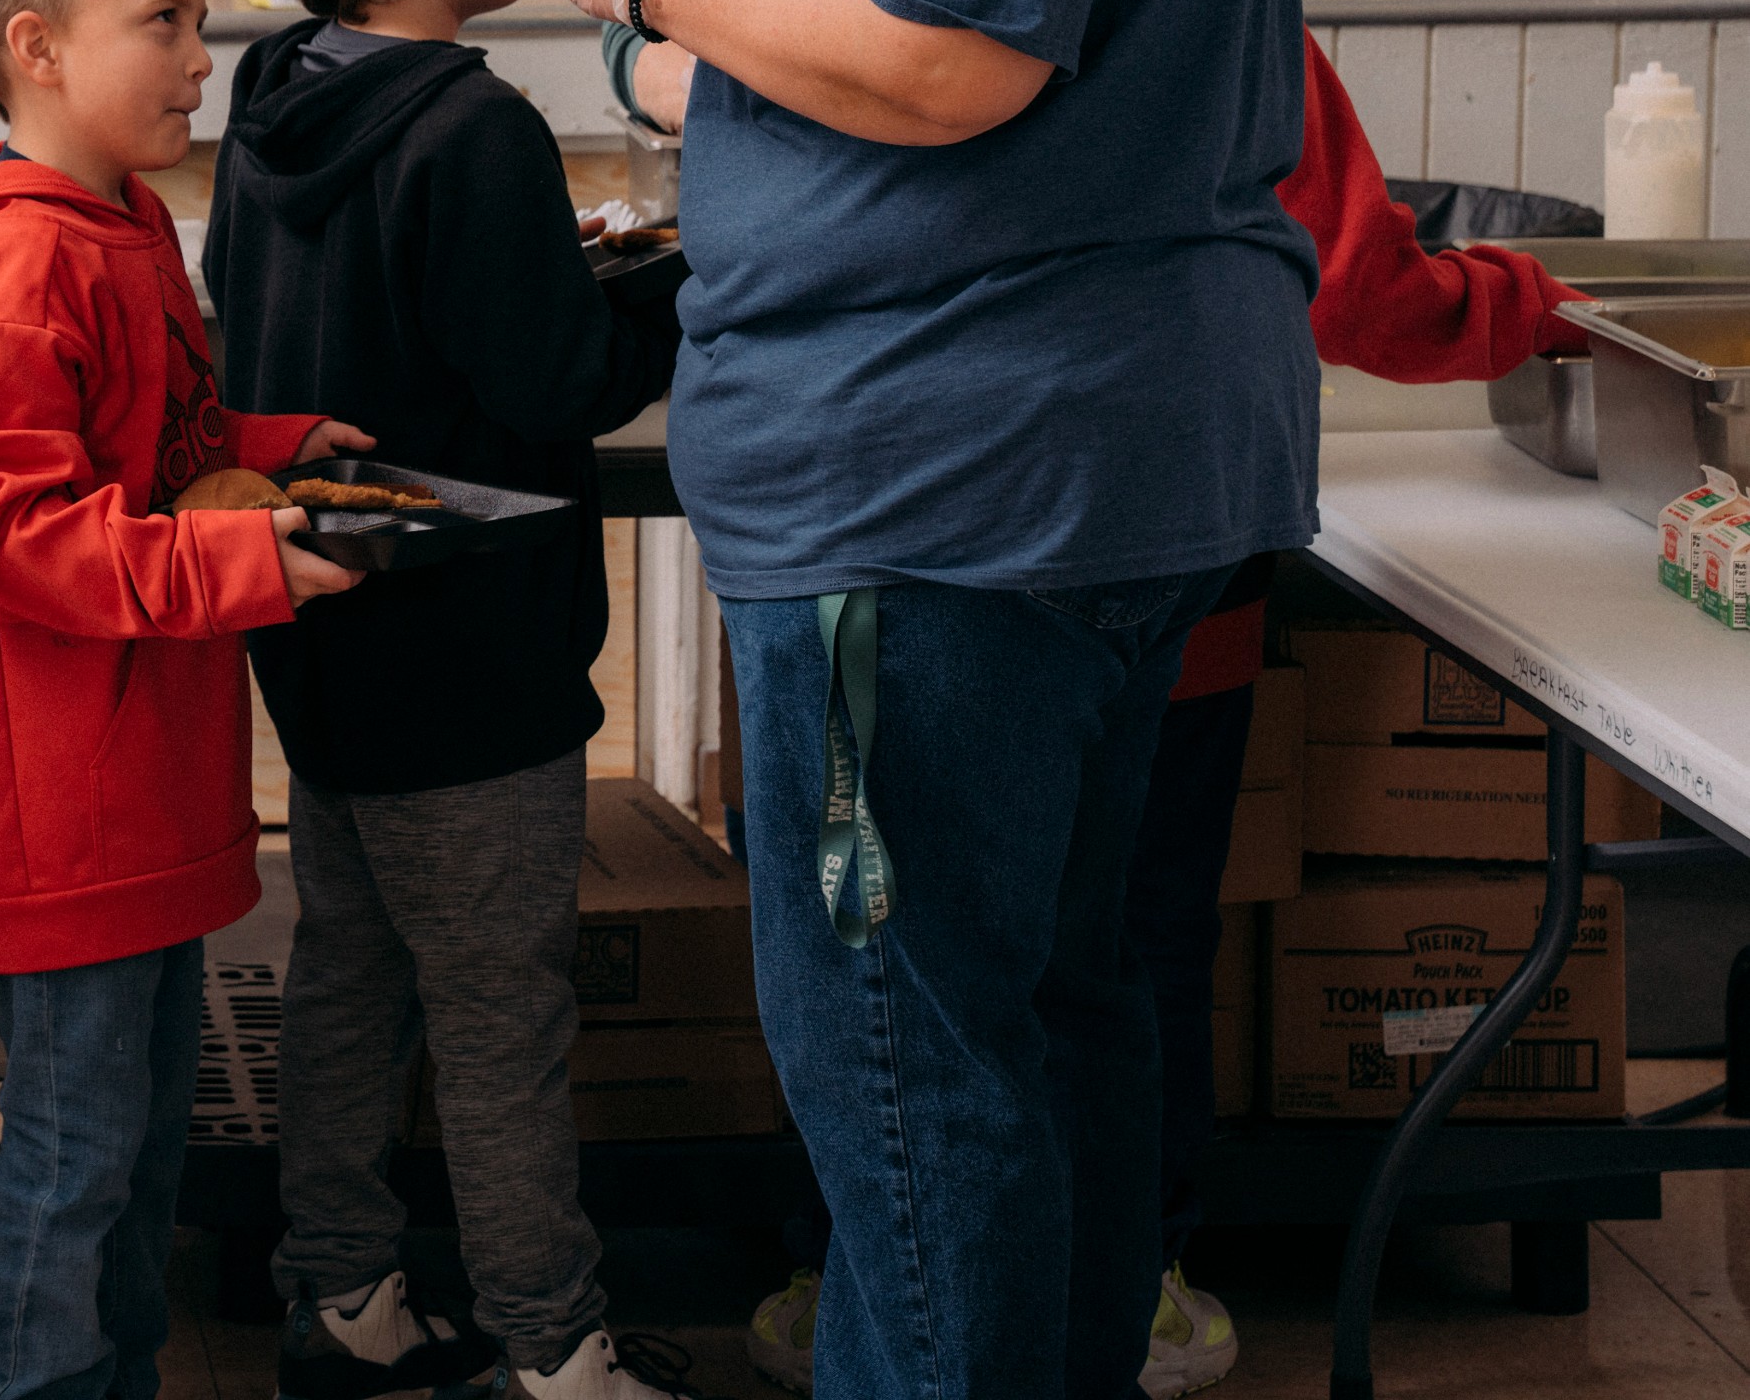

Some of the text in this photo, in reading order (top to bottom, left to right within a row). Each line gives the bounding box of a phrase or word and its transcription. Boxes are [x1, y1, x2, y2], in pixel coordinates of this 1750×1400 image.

[1417, 933, 1476, 954] HEINZ
[1412, 962, 1484, 981] POUCH PACK
[1322, 987, 1438, 1013] TOMATO
